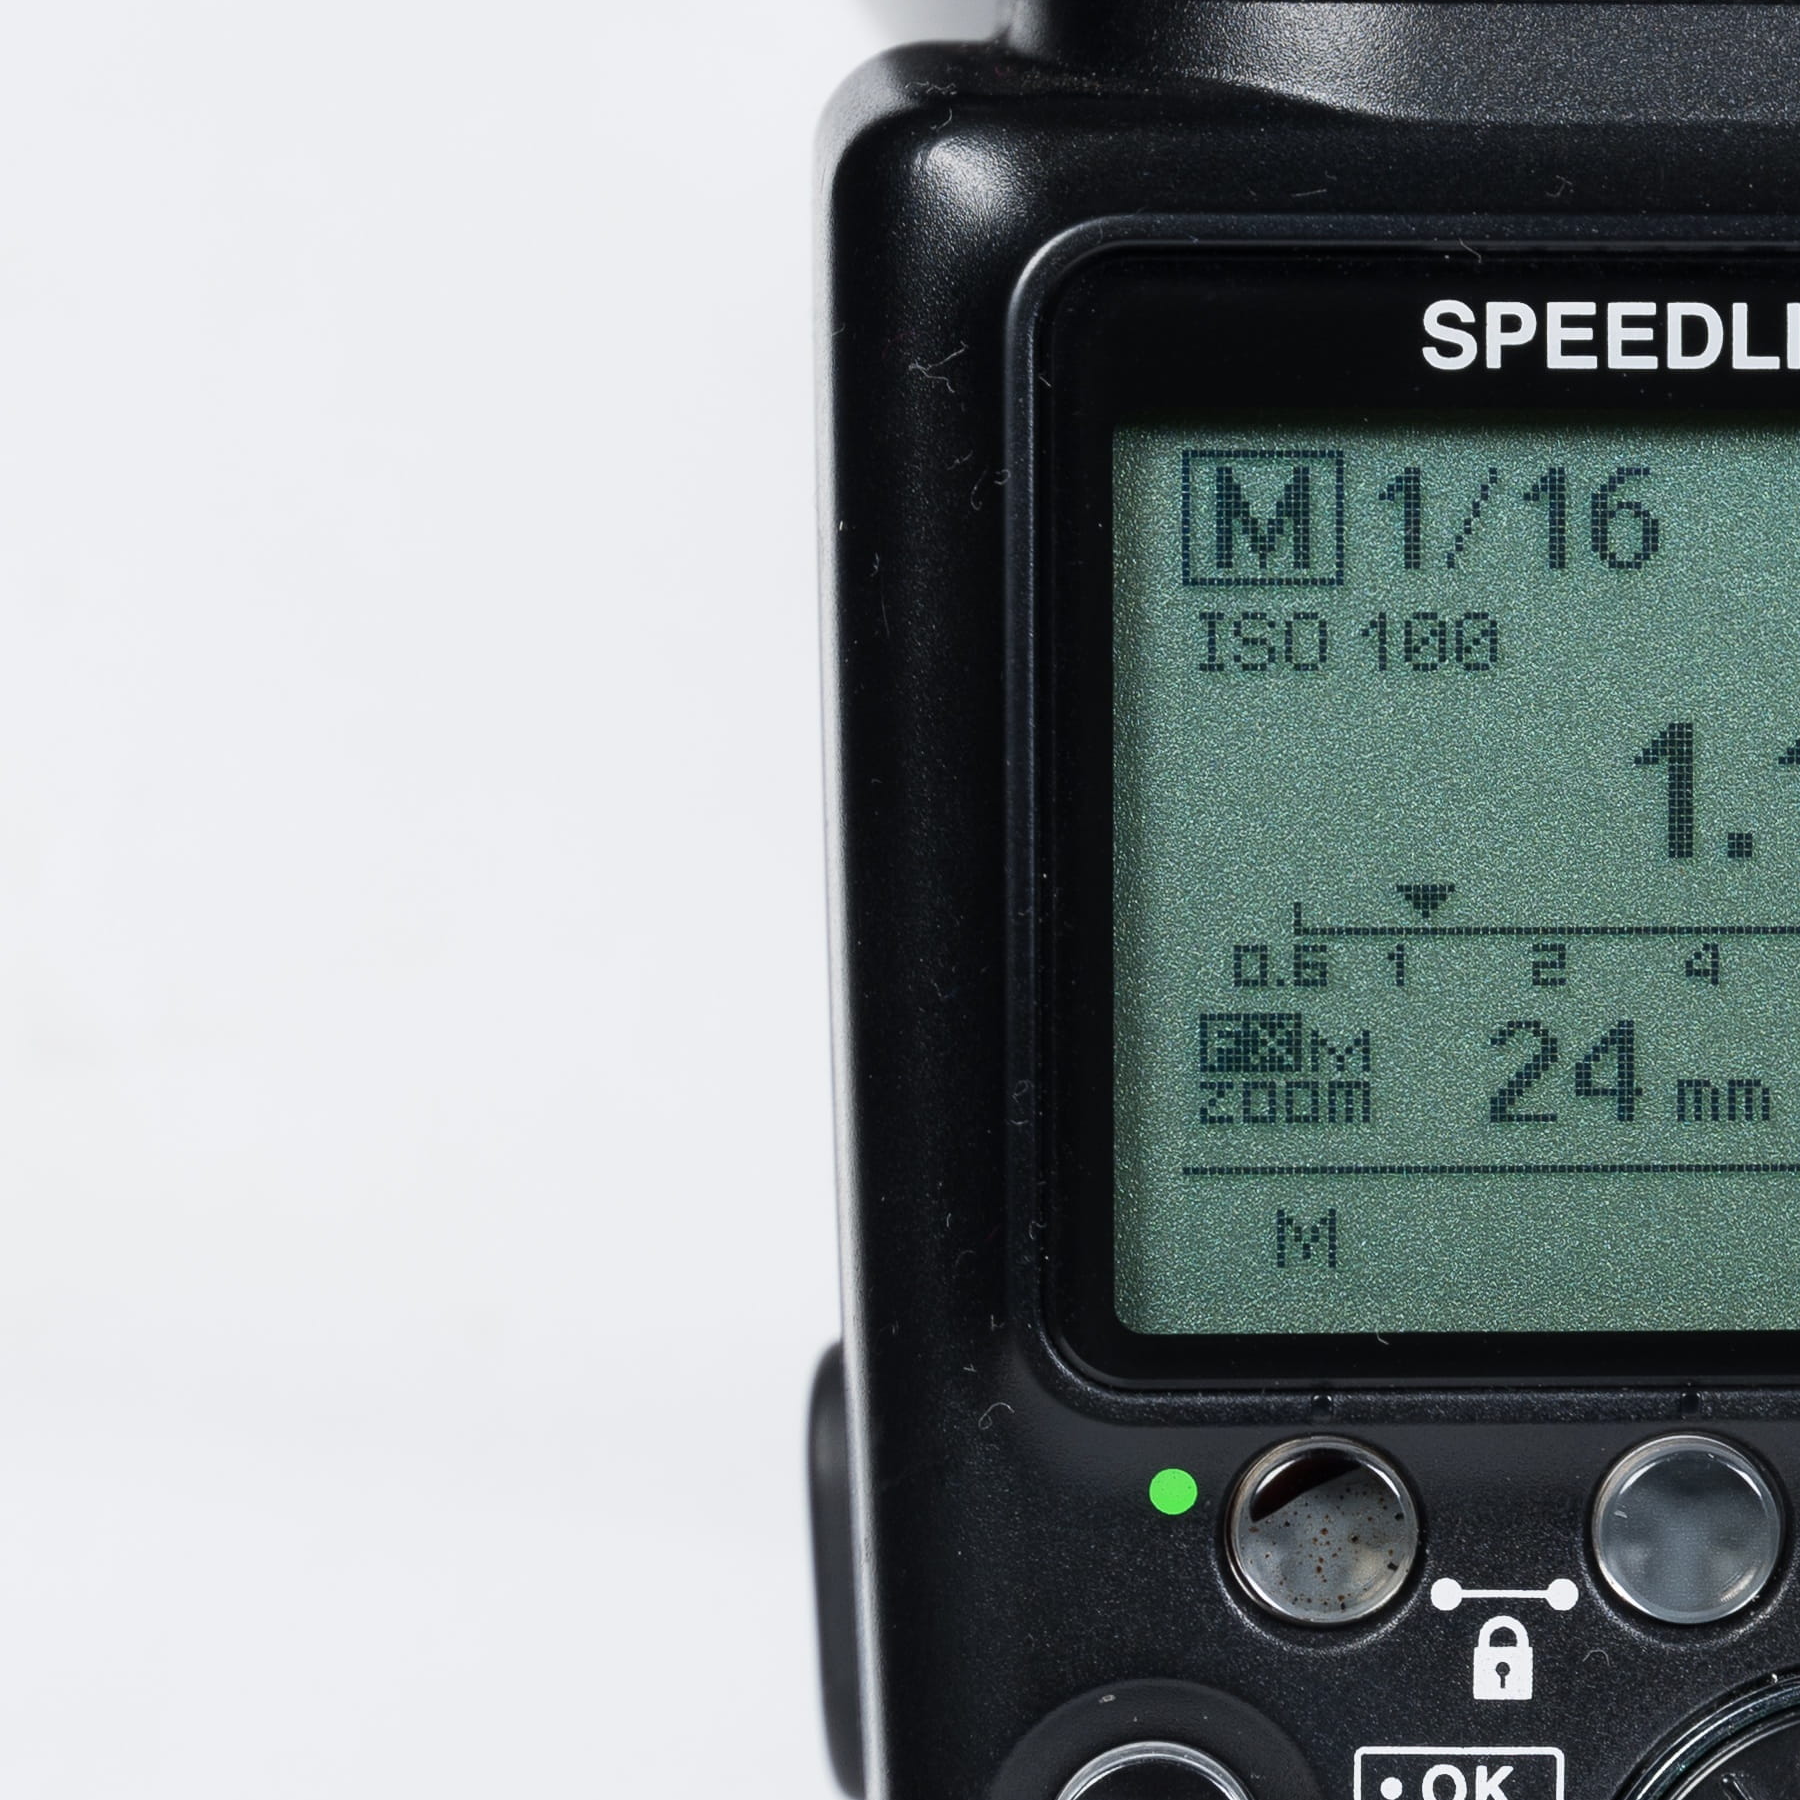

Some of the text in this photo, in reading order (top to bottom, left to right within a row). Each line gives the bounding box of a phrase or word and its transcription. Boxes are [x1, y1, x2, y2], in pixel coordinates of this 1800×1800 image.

[1215, 465, 1662, 570] M 1/16
[1199, 610, 1500, 673] ISO 100
[1232, 943, 1329, 988] 0.6
[1386, 943, 1406, 987] 1
[1531, 942, 1568, 987] 2
[1684, 942, 1720, 986] 4
[1489, 1019, 1644, 1123] 24
[1676, 1078, 1771, 1123] mm
[1275, 1207, 1340, 1269] M
